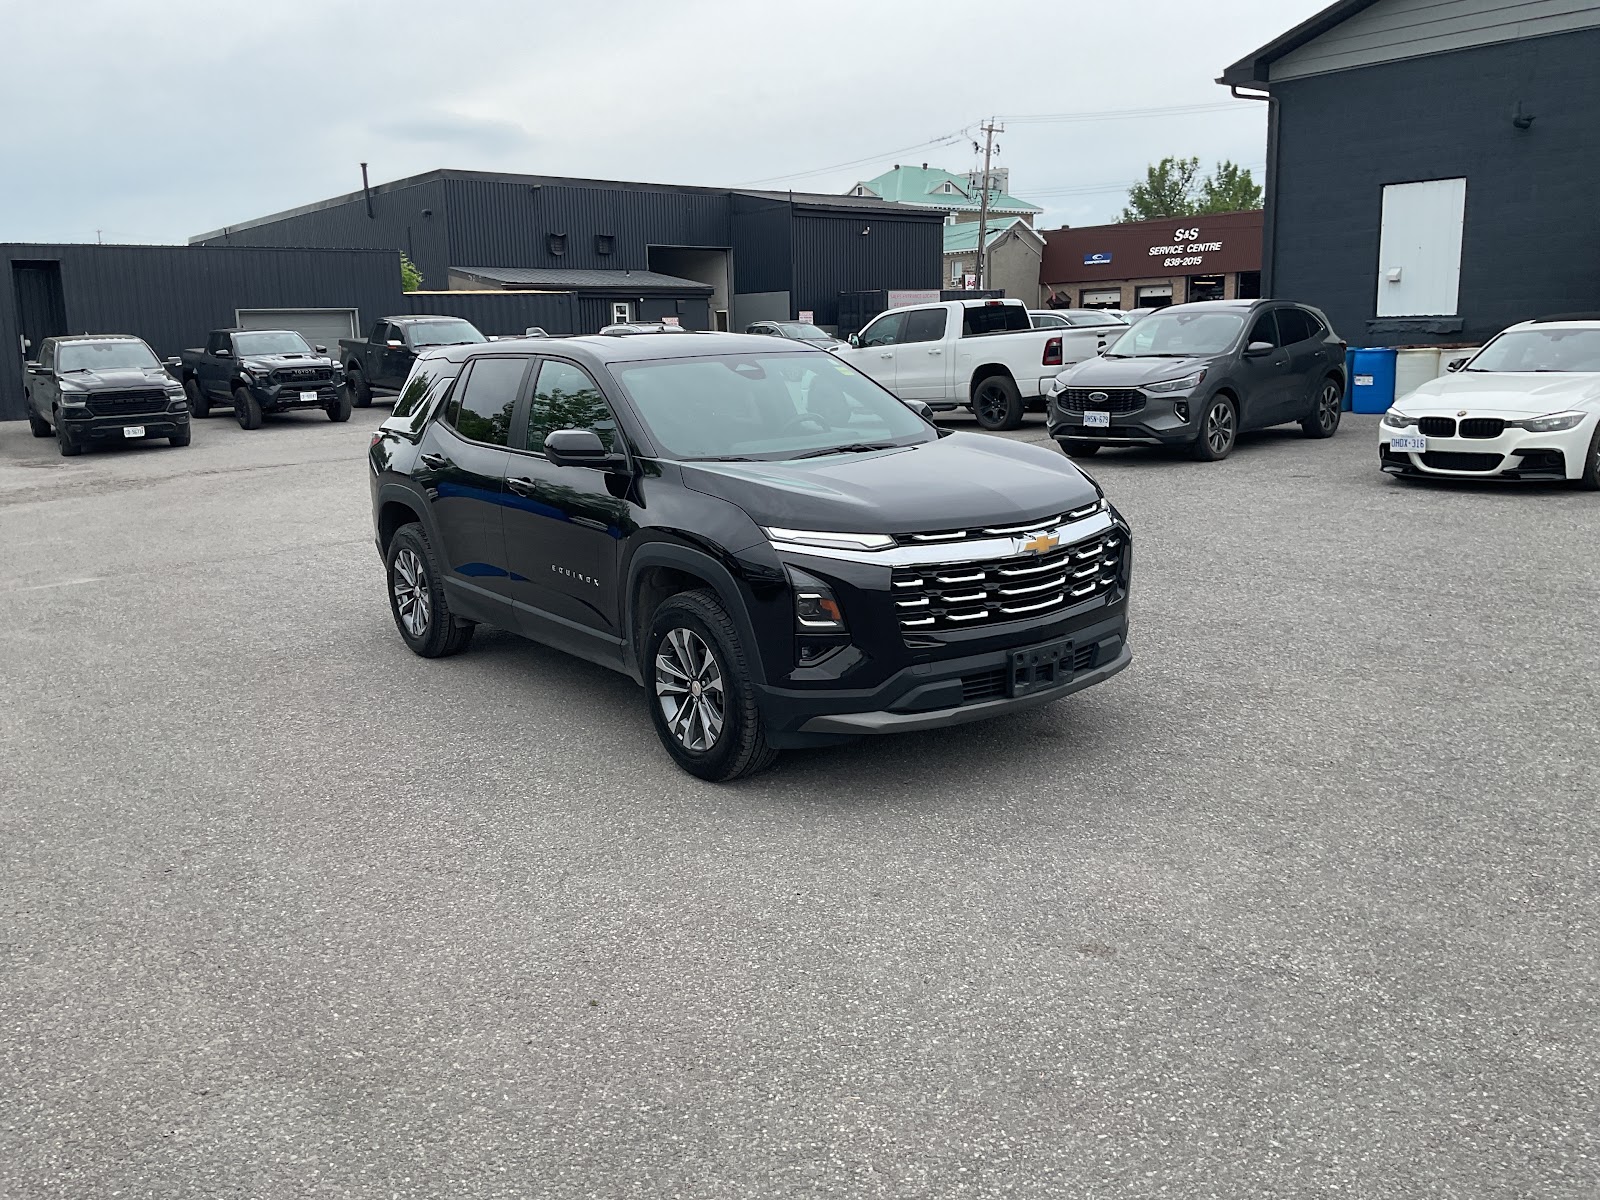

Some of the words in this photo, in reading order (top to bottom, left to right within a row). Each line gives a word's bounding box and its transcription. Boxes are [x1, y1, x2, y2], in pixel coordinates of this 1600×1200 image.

[1173, 227, 1199, 242] S&S
[1148, 244, 1184, 256] SERVICE
[1186, 241, 1222, 254] CENTRE
[1163, 256, 1203, 267] 838-2015
[551, 564, 600, 587] EQUINOX
